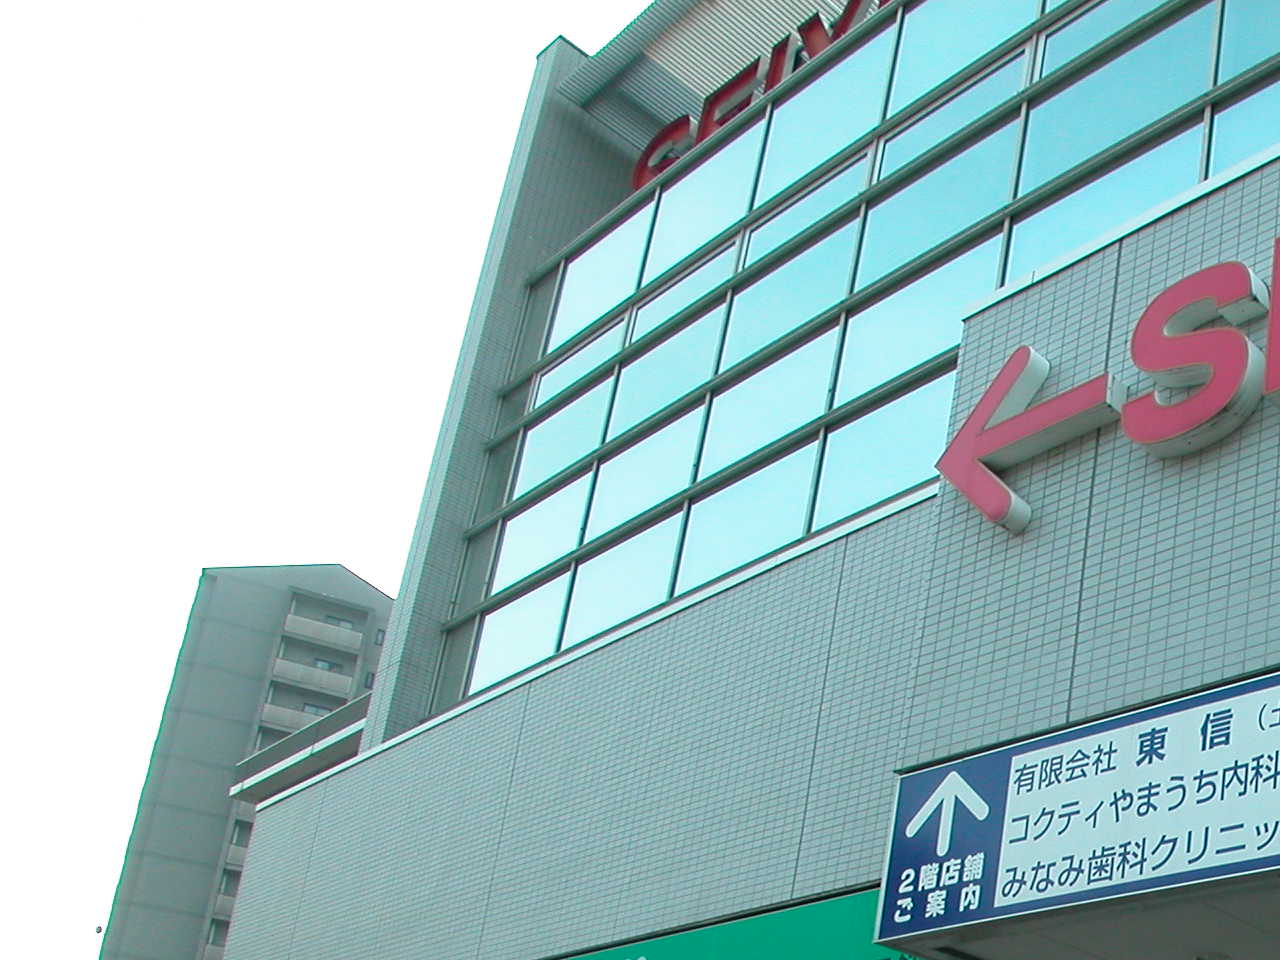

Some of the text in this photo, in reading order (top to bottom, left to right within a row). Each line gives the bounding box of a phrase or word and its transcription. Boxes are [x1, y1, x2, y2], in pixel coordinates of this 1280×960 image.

[1013, 740, 1118, 796] 有限会社
[898, 852, 985, 893] 2階店舗
